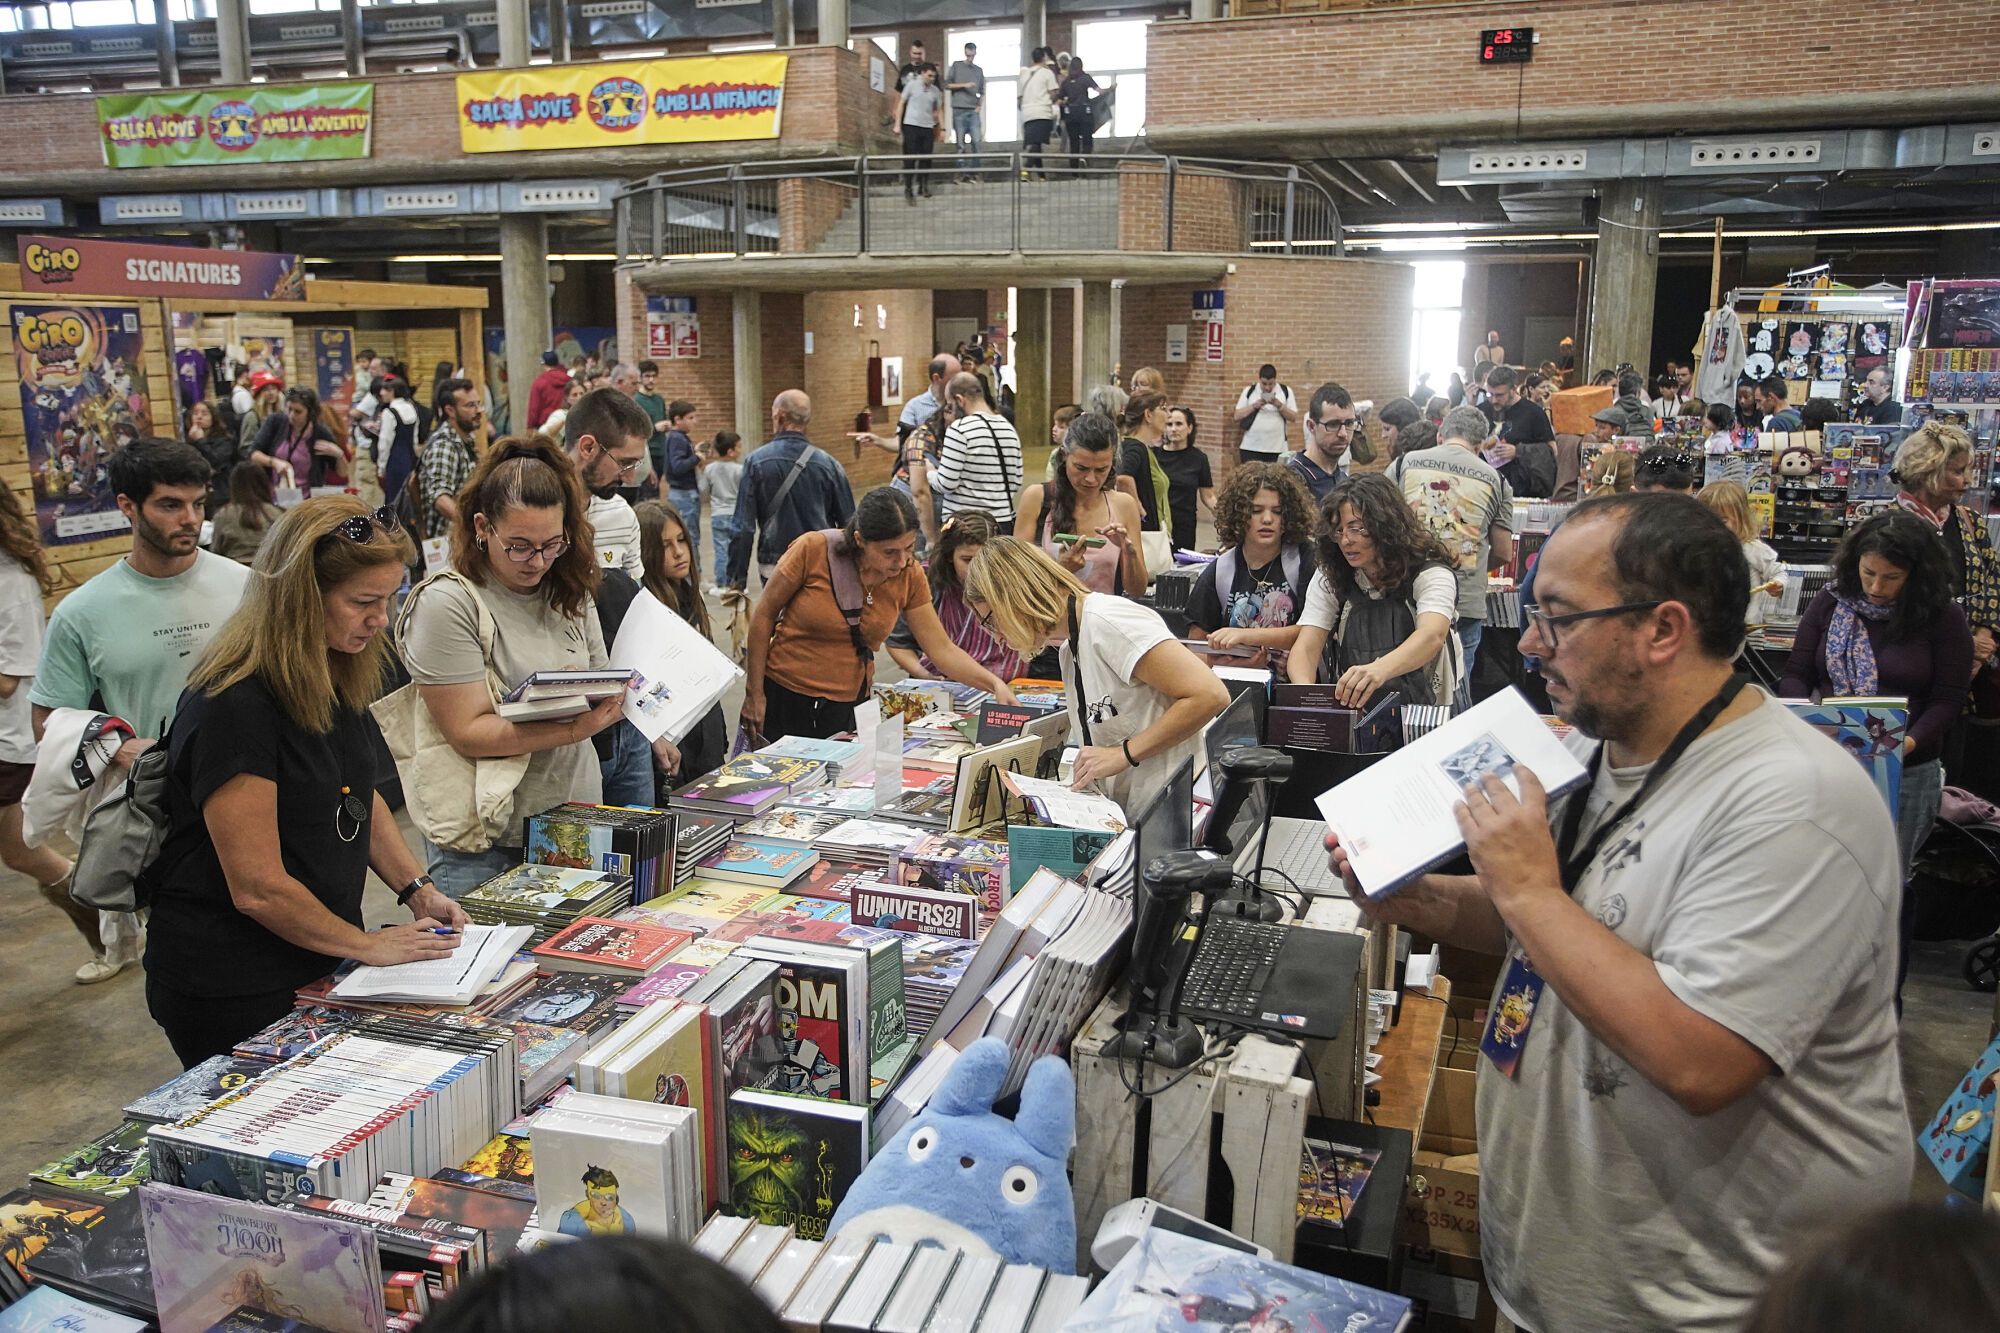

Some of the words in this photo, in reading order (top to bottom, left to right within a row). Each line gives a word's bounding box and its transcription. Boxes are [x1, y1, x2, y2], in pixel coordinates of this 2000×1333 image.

[1494, 30, 1512, 43] 25
[470, 103, 524, 123] SALSA
[527, 98, 573, 120] JOVE
[655, 92, 689, 113] AMB
[691, 91, 711, 111] LA
[110, 119, 155, 141] SALSA
[157, 118, 197, 139] JOVE
[261, 117, 289, 134] AMB
[290, 115, 306, 132] LA
[126, 258, 242, 286] SIGNATURES
[1407, 459, 1446, 471] VINCENT
[1448, 463, 1467, 476] VAN
[1467, 468, 1496, 483] GOGH
[153, 627, 175, 637] STAY
[177, 622, 210, 633] UNITED
[988, 873, 1000, 912] ZEROCA
[917, 925, 936, 934] ALBERT
[936, 927, 961, 937] MONTEYS
[218, 1213, 278, 1235] STRAWBERRY
[800, 1215, 828, 1236] COSA
[217, 1225, 284, 1258] MOON
